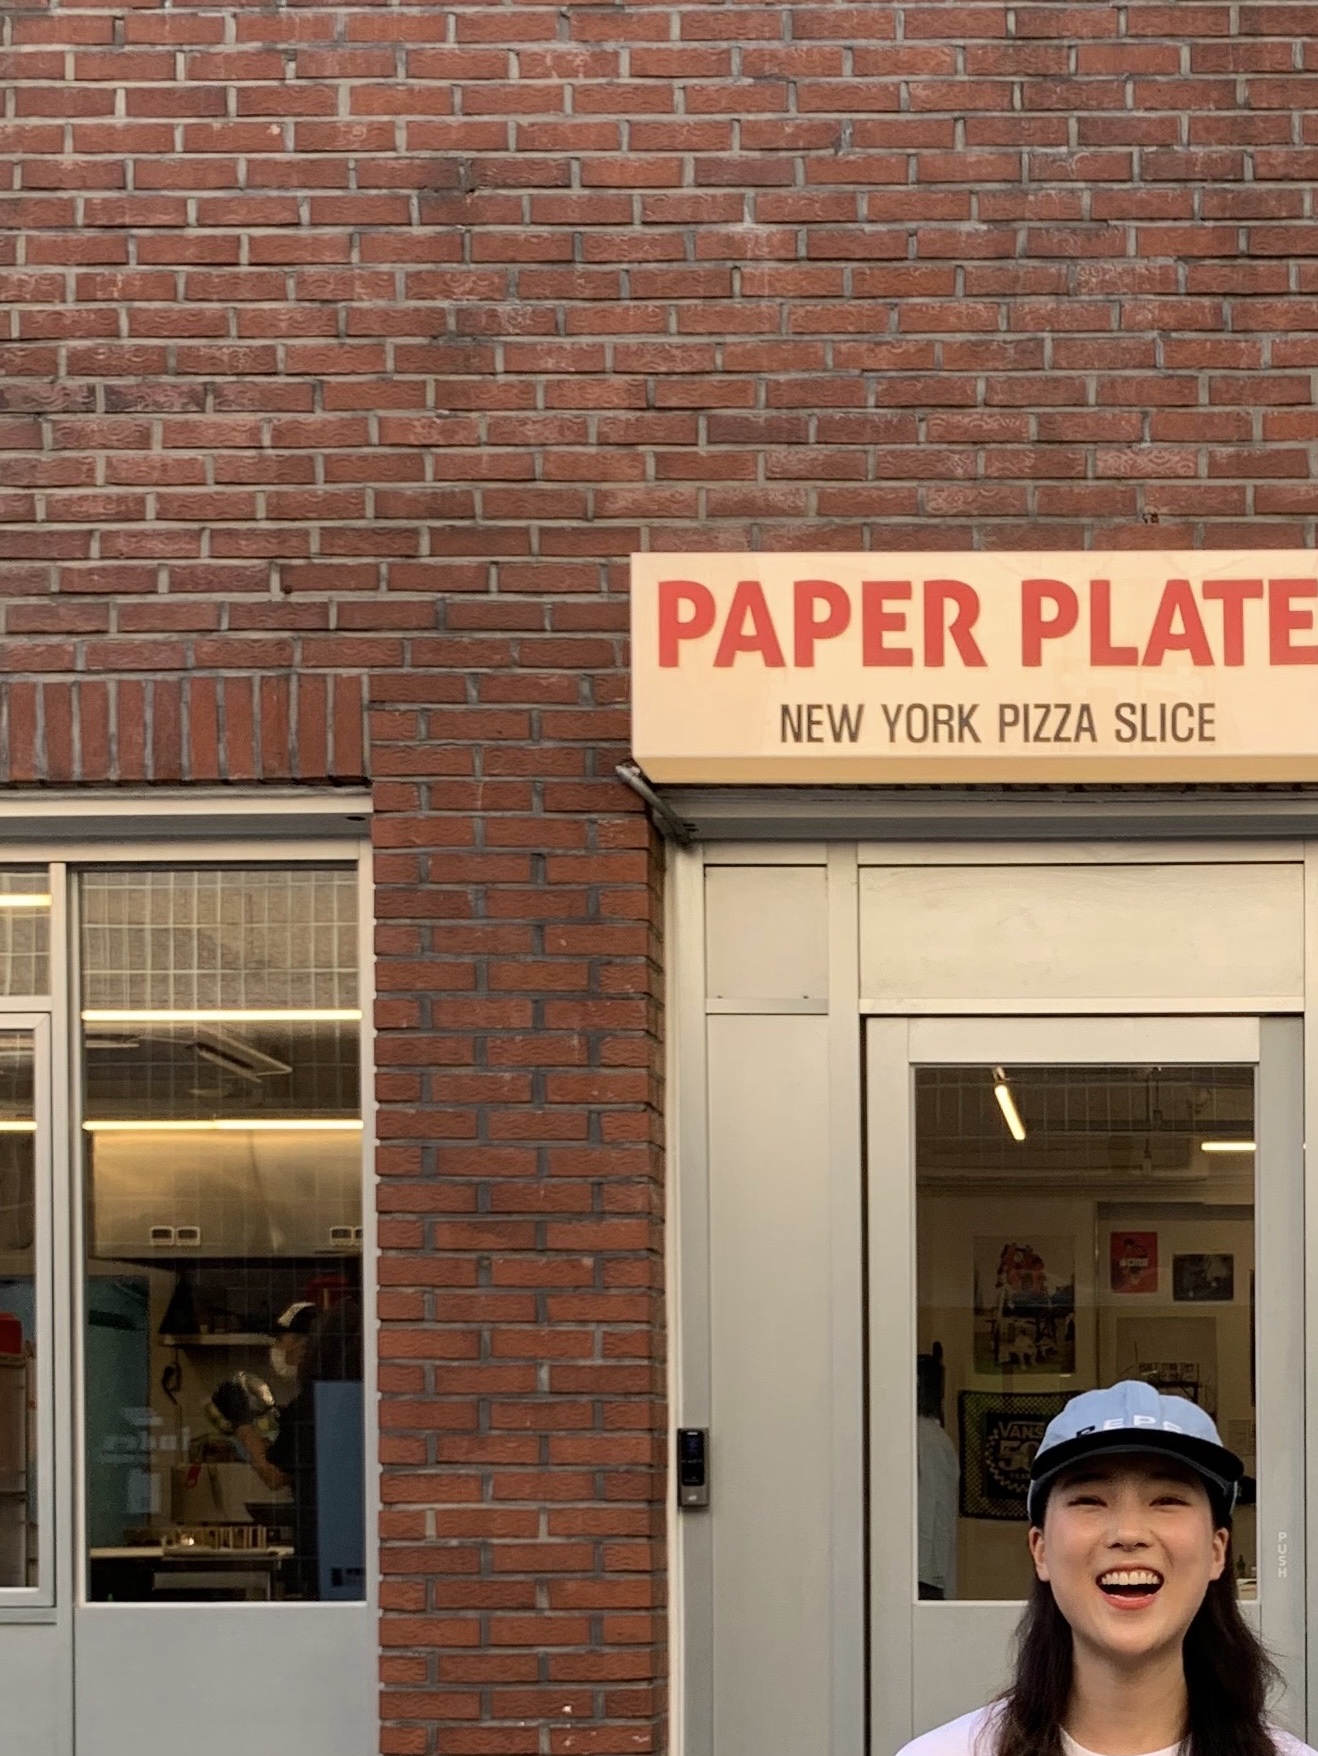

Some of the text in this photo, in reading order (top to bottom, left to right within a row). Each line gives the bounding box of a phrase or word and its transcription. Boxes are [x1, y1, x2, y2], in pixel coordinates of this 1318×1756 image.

[657, 579, 987, 669] PAPER
[780, 702, 1217, 743] NEW YORK PIZZA SLICE
[998, 1420, 1046, 1440] VANS
[1277, 1531, 1287, 1578] PUSH
